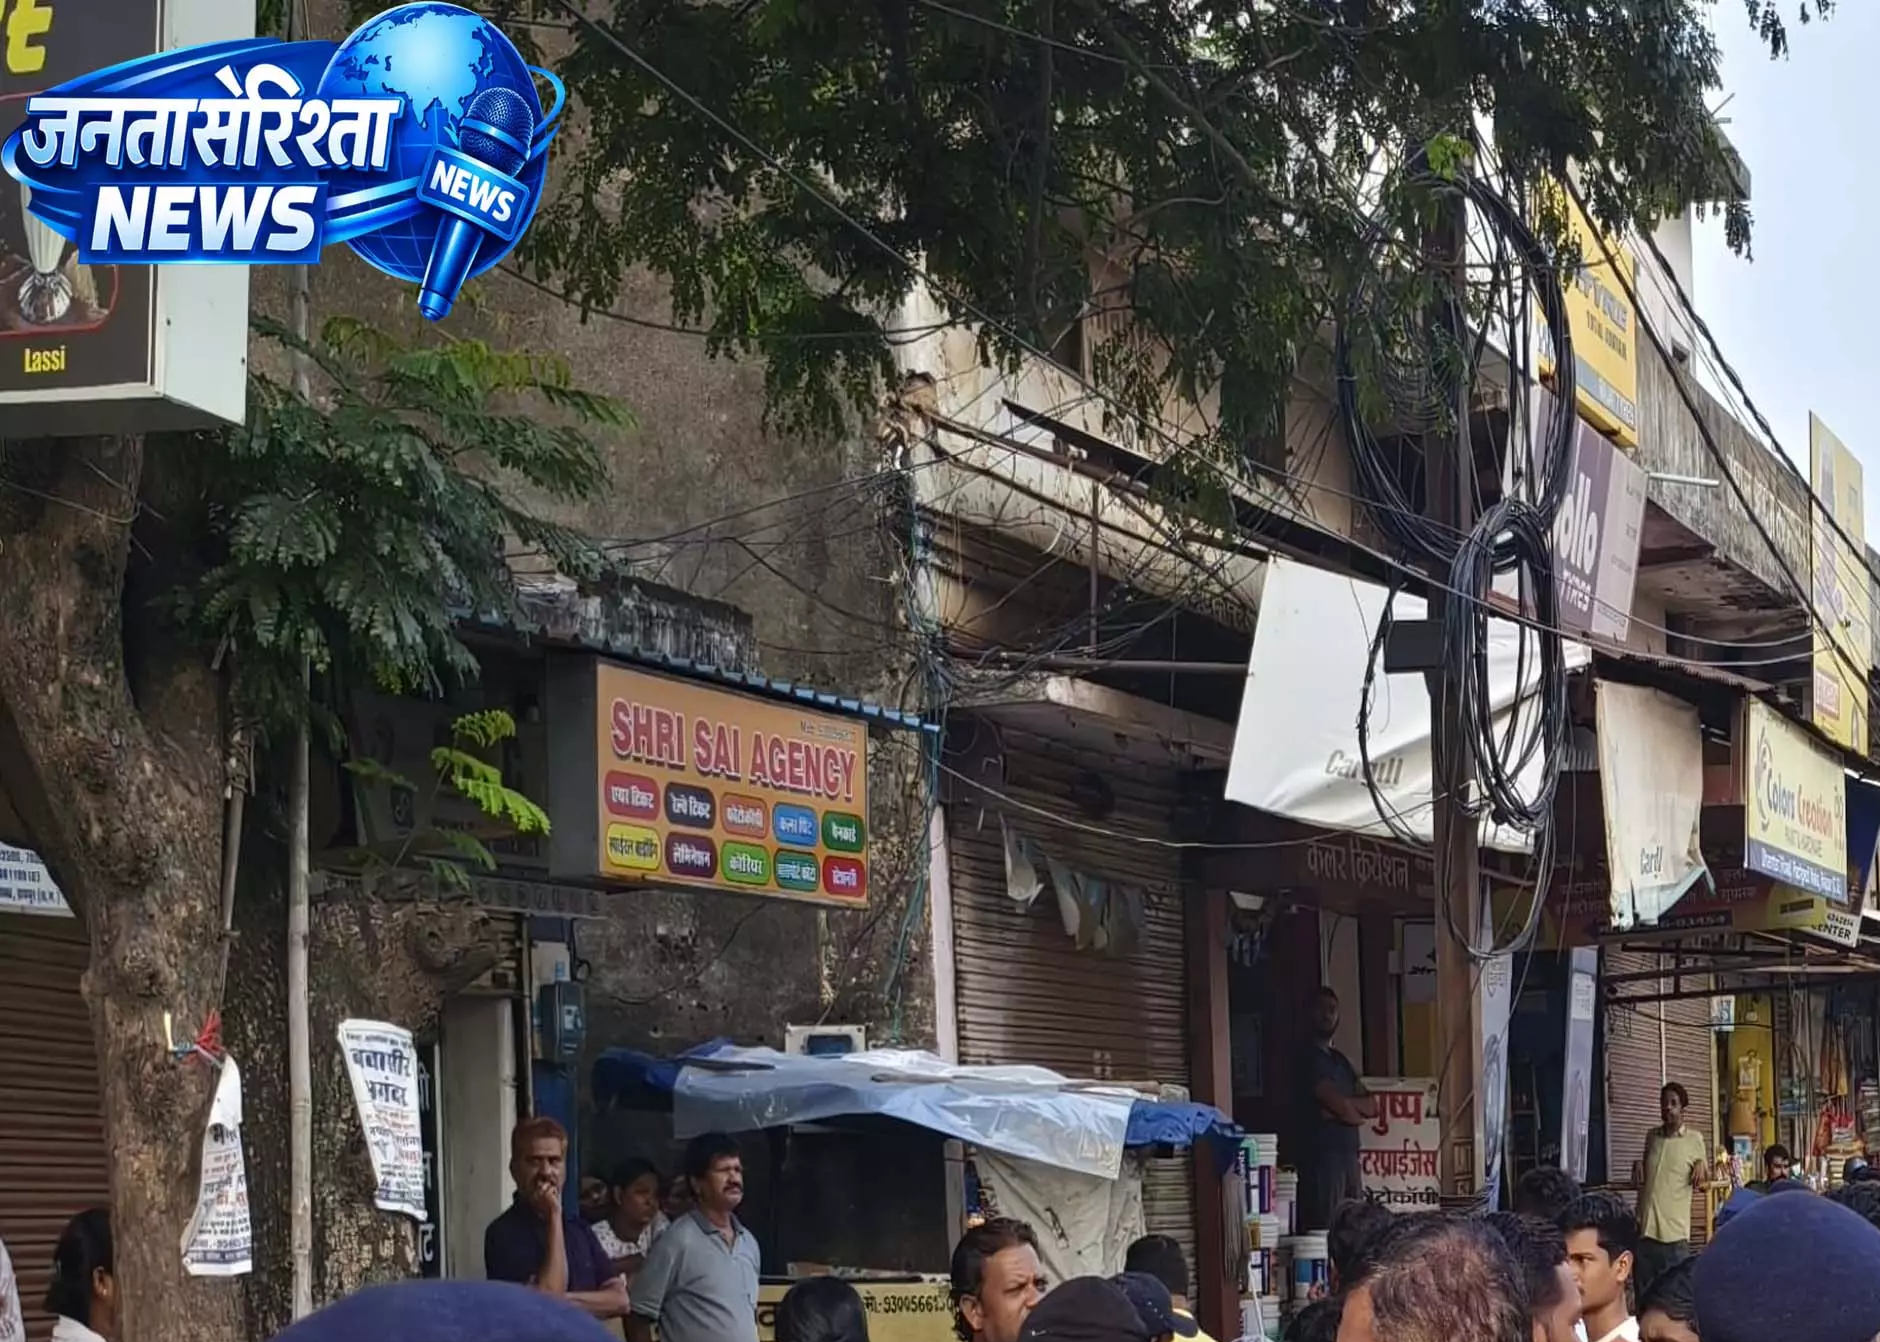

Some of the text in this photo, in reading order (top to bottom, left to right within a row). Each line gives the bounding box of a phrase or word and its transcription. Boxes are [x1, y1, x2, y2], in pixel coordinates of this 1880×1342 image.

[24, 346, 66, 373] Lassi
[611, 698, 857, 800] SHRI SAI AGENCY
[1767, 768, 1832, 839] Colors Creation
[1811, 923, 1851, 940] ENTER
